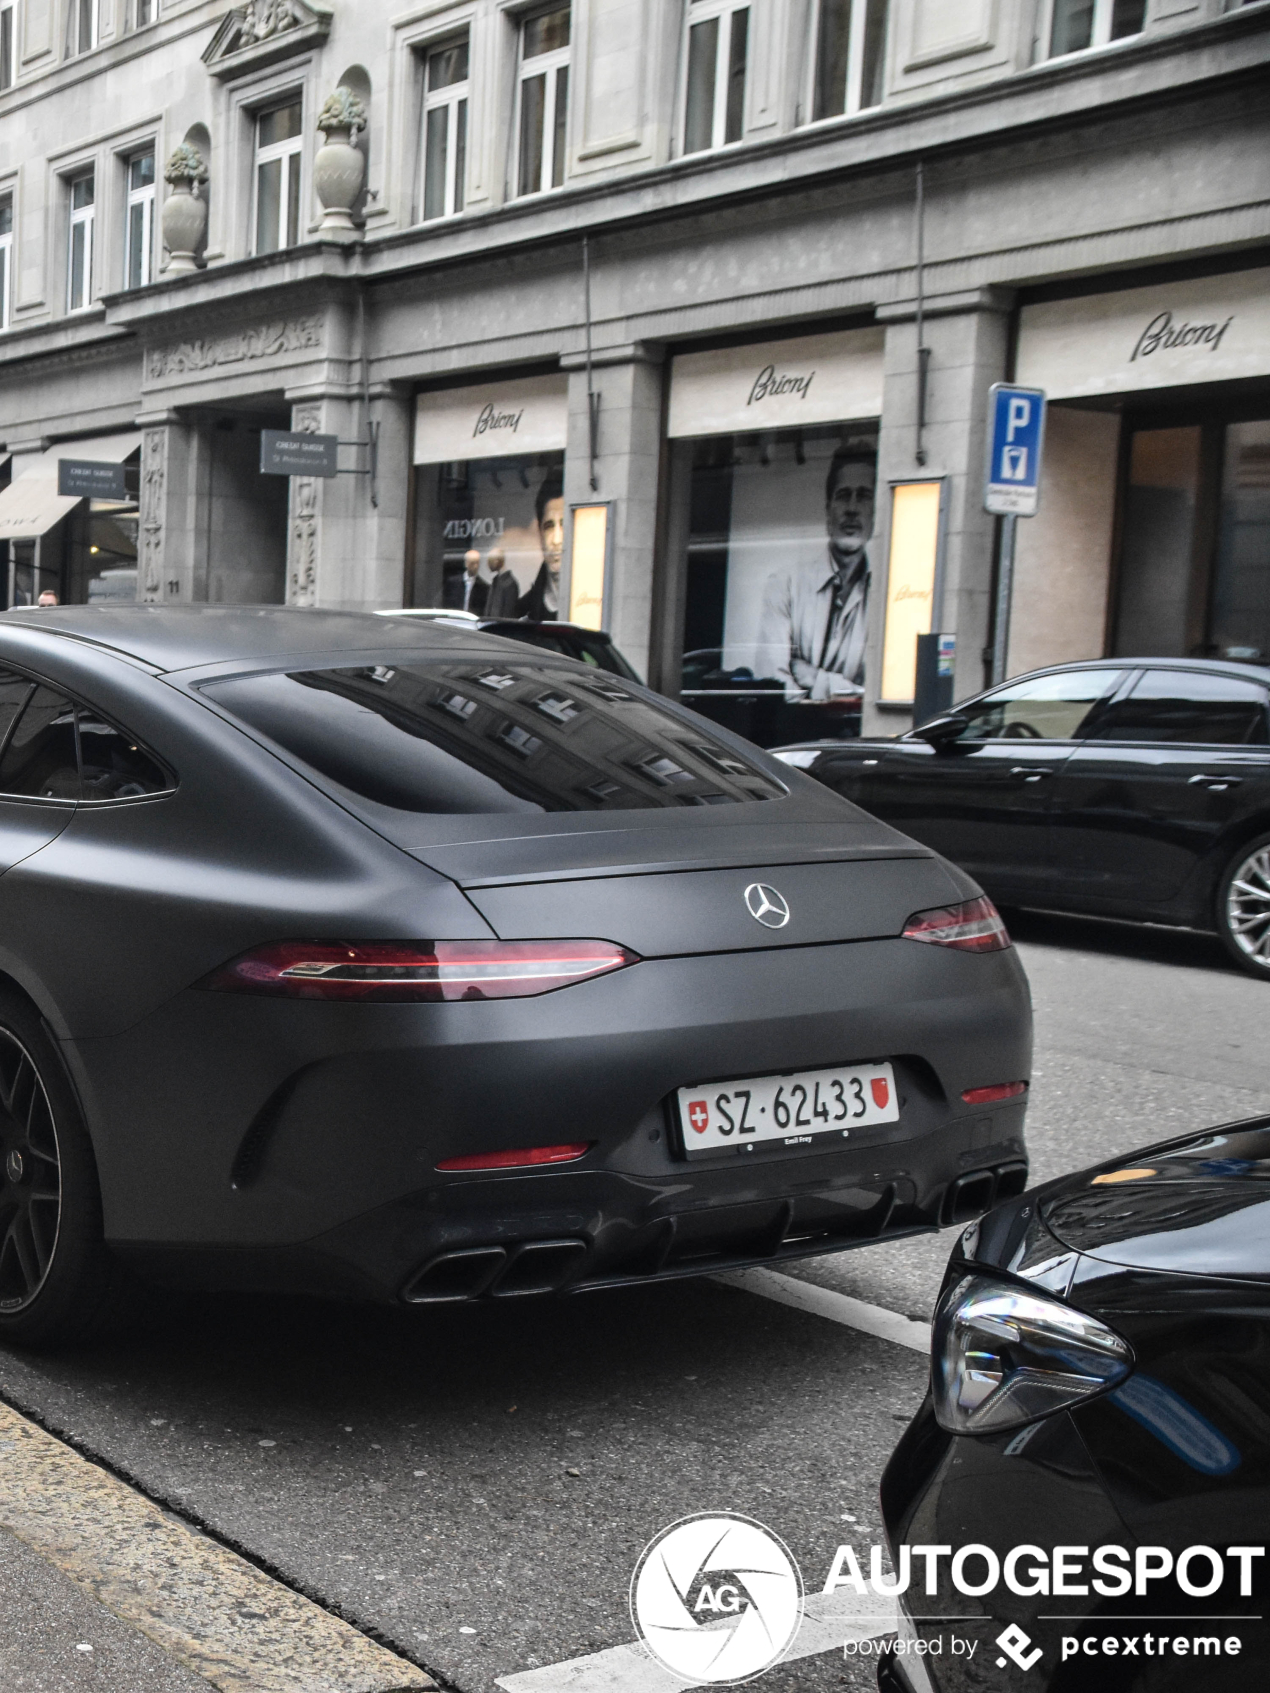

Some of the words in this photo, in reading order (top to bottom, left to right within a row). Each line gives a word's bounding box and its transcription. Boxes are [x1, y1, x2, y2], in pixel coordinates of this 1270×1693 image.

[1129, 310, 1235, 362] Brioni
[747, 365, 816, 406] Brioni
[472, 403, 524, 438] Brioni
[1006, 397, 1031, 443] P
[167, 580, 180, 594] 11
[784, 1137, 798, 1145] Emil
[799, 1135, 813, 1145] Frey
